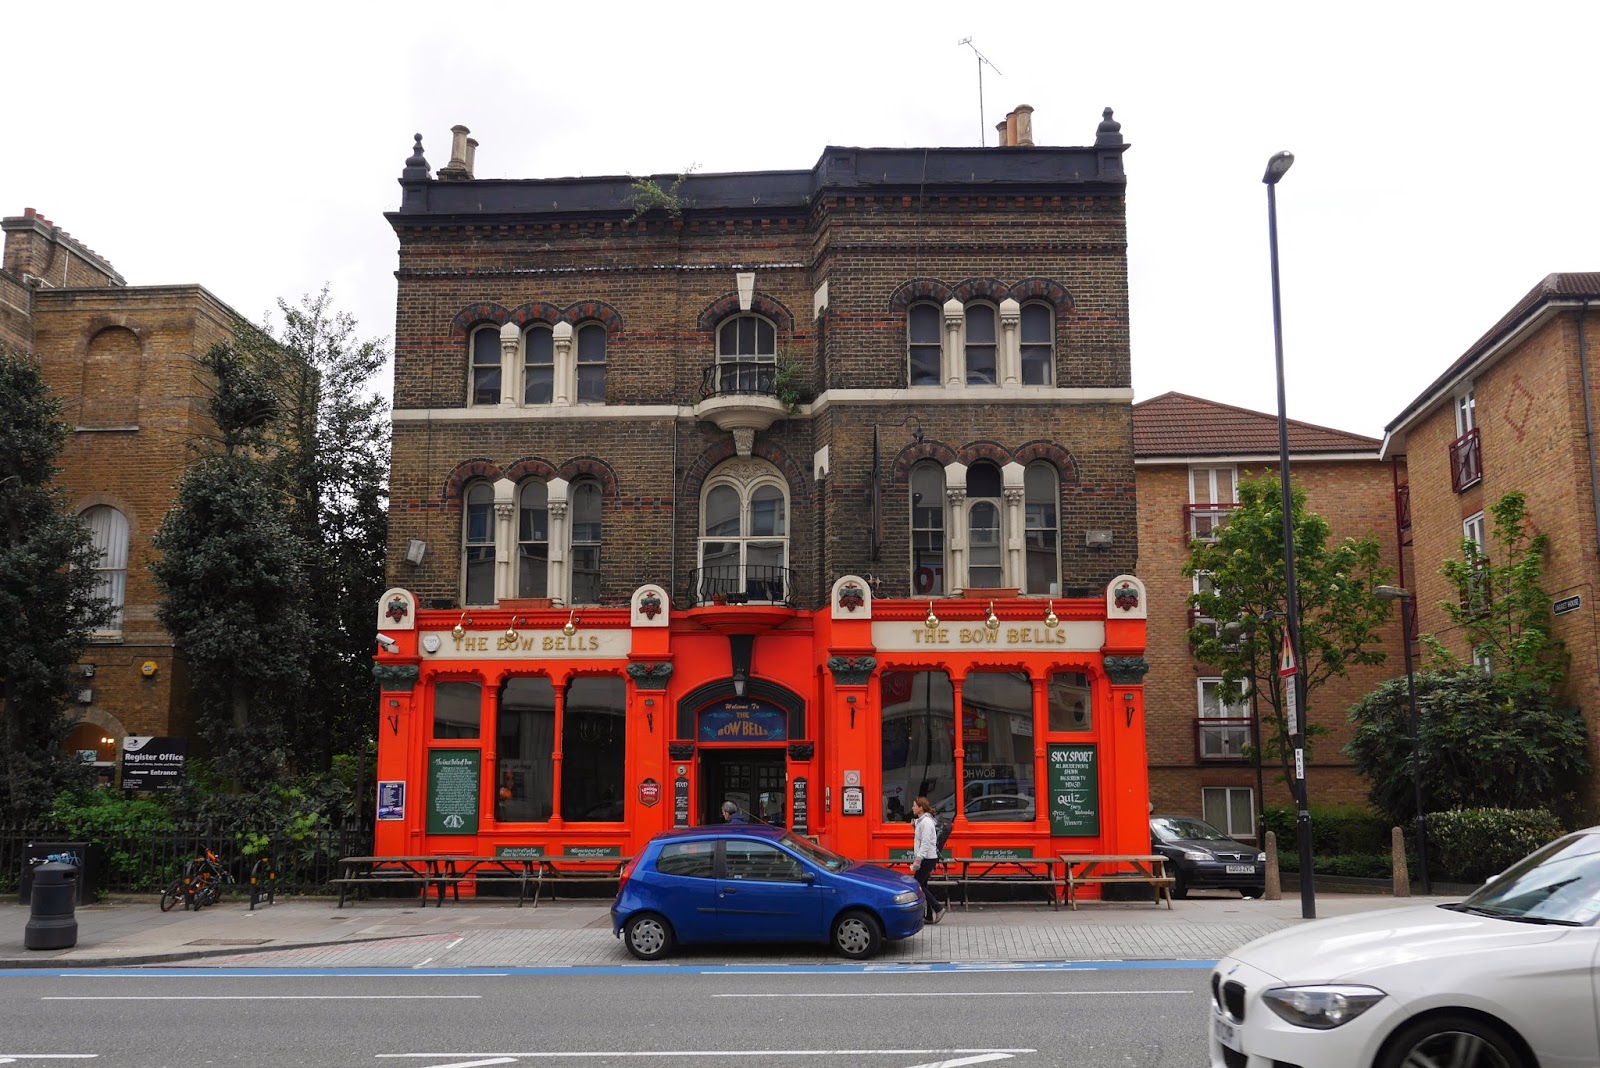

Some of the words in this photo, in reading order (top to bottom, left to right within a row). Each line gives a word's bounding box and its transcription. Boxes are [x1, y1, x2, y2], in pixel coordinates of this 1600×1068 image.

[912, 628, 950, 643] THE
[960, 627, 999, 643] BOW
[1007, 628, 1067, 644] BELLS
[453, 636, 489, 651] THE
[497, 636, 533, 651] BOW
[543, 636, 599, 650] BELLS
[717, 721, 741, 736] BOW
[742, 721, 768, 736] BELLS
[125, 753, 158, 762] Register
[158, 753, 184, 761] Office
[1051, 751, 1069, 762] SKY
[1069, 751, 1094, 762] SPORT
